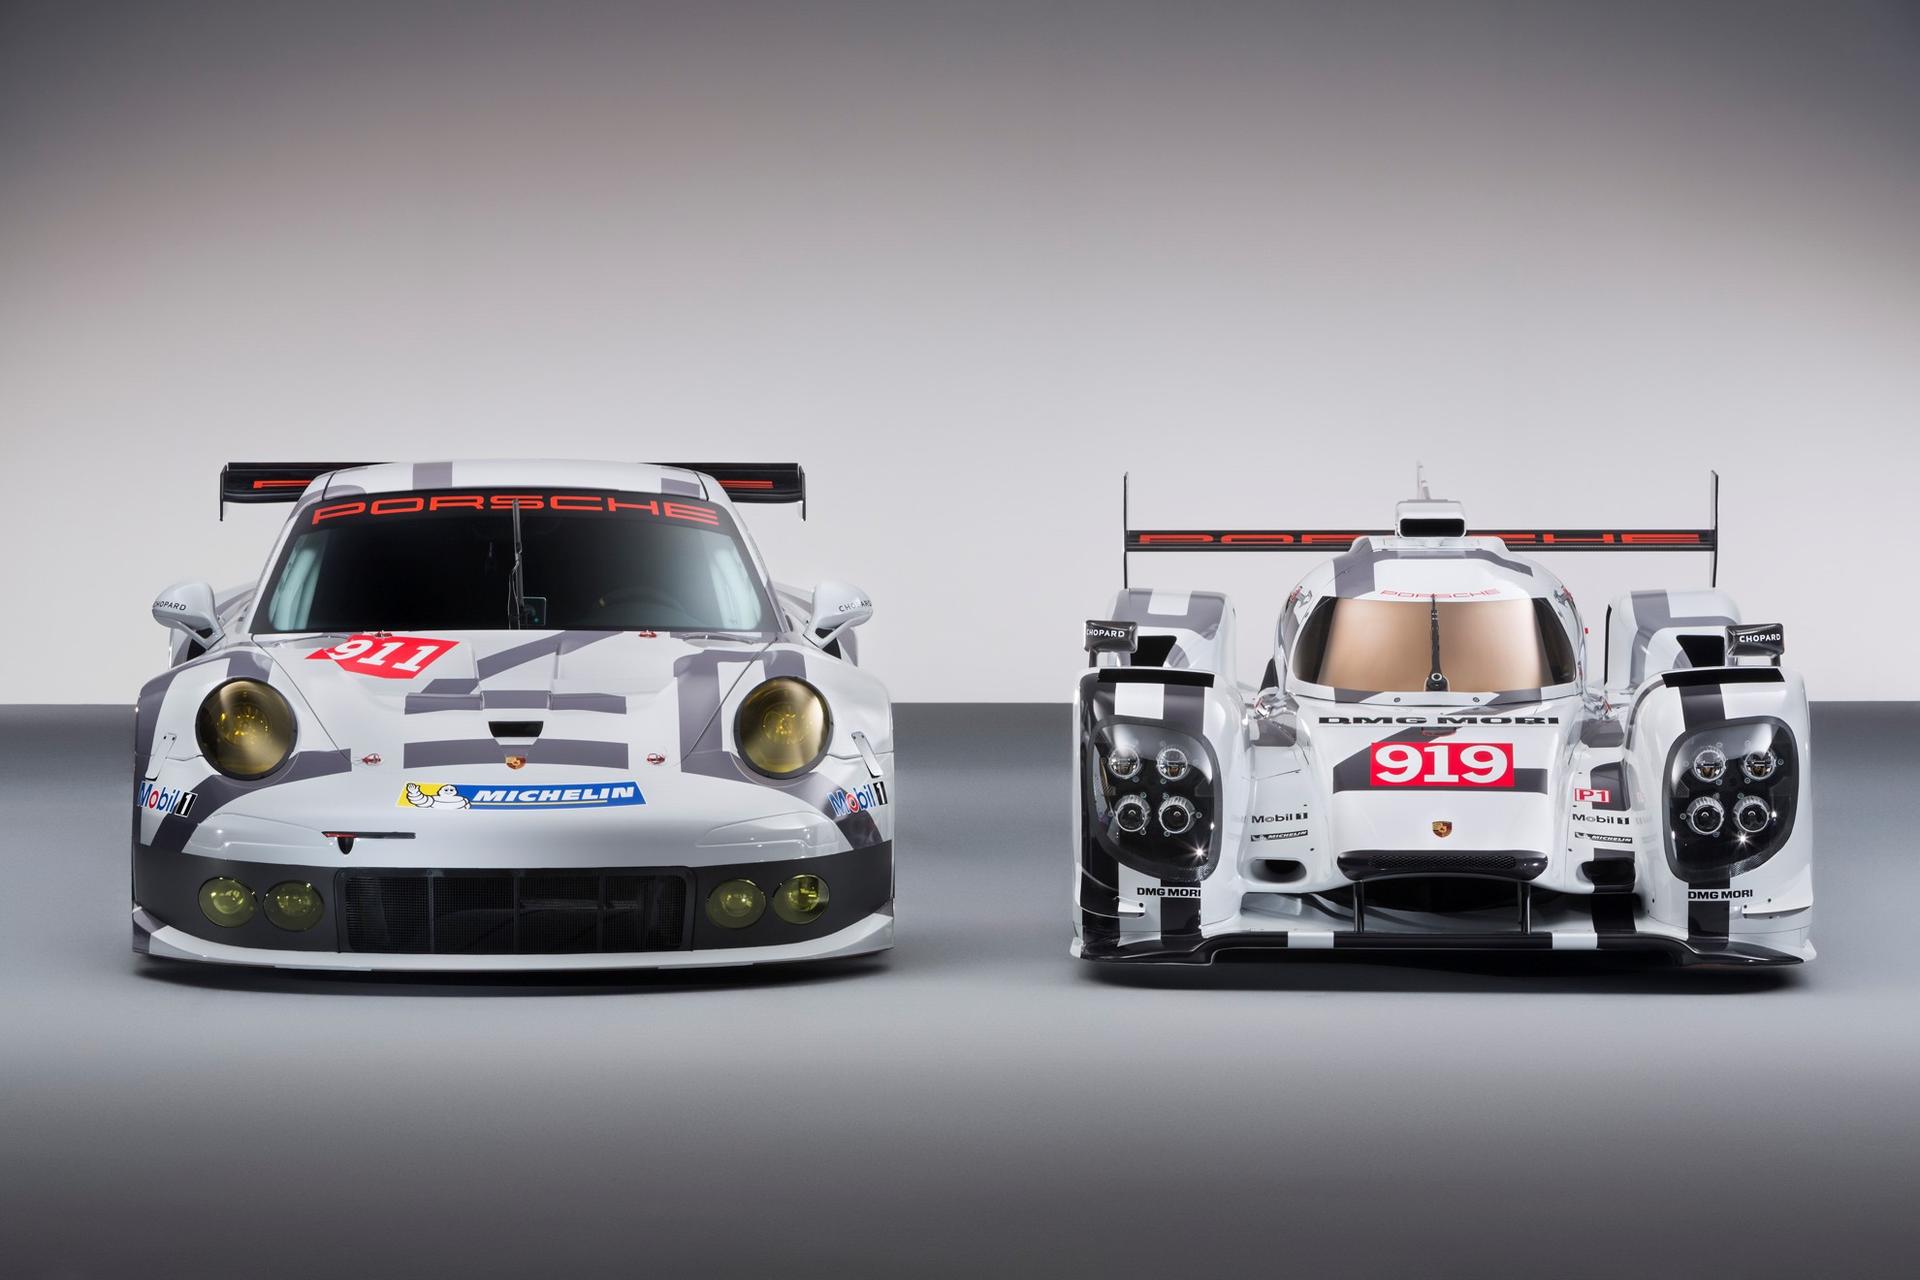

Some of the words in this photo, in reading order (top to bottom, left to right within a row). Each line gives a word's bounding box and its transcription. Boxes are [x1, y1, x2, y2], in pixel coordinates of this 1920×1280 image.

[312, 495, 720, 526] PORSCHE
[1139, 533, 1699, 544] PORHE
[1380, 588, 1501, 599] PORSCHE
[838, 599, 872, 612] CHOAR
[1739, 633, 1781, 643] CHOPARD
[324, 639, 440, 673] 911
[1318, 716, 1427, 725] DMG
[1436, 716, 1559, 725] MORI
[1375, 743, 1508, 784] 919
[137, 781, 181, 814] Mobil
[178, 792, 196, 817] 1
[472, 786, 635, 802] MICHELIN
[827, 783, 876, 817] Mobil
[874, 781, 887, 806] 1
[1580, 788, 1607, 802] P1
[1251, 813, 1293, 824] Mobil
[1572, 813, 1615, 824] Mobil
[1267, 830, 1307, 840] MICHELIN
[1591, 834, 1632, 843] MICHELIN
[1136, 886, 1166, 897] DMG
[1167, 887, 1202, 898] MORI
[1687, 891, 1719, 900] DMG
[1721, 889, 1753, 899] MORI
